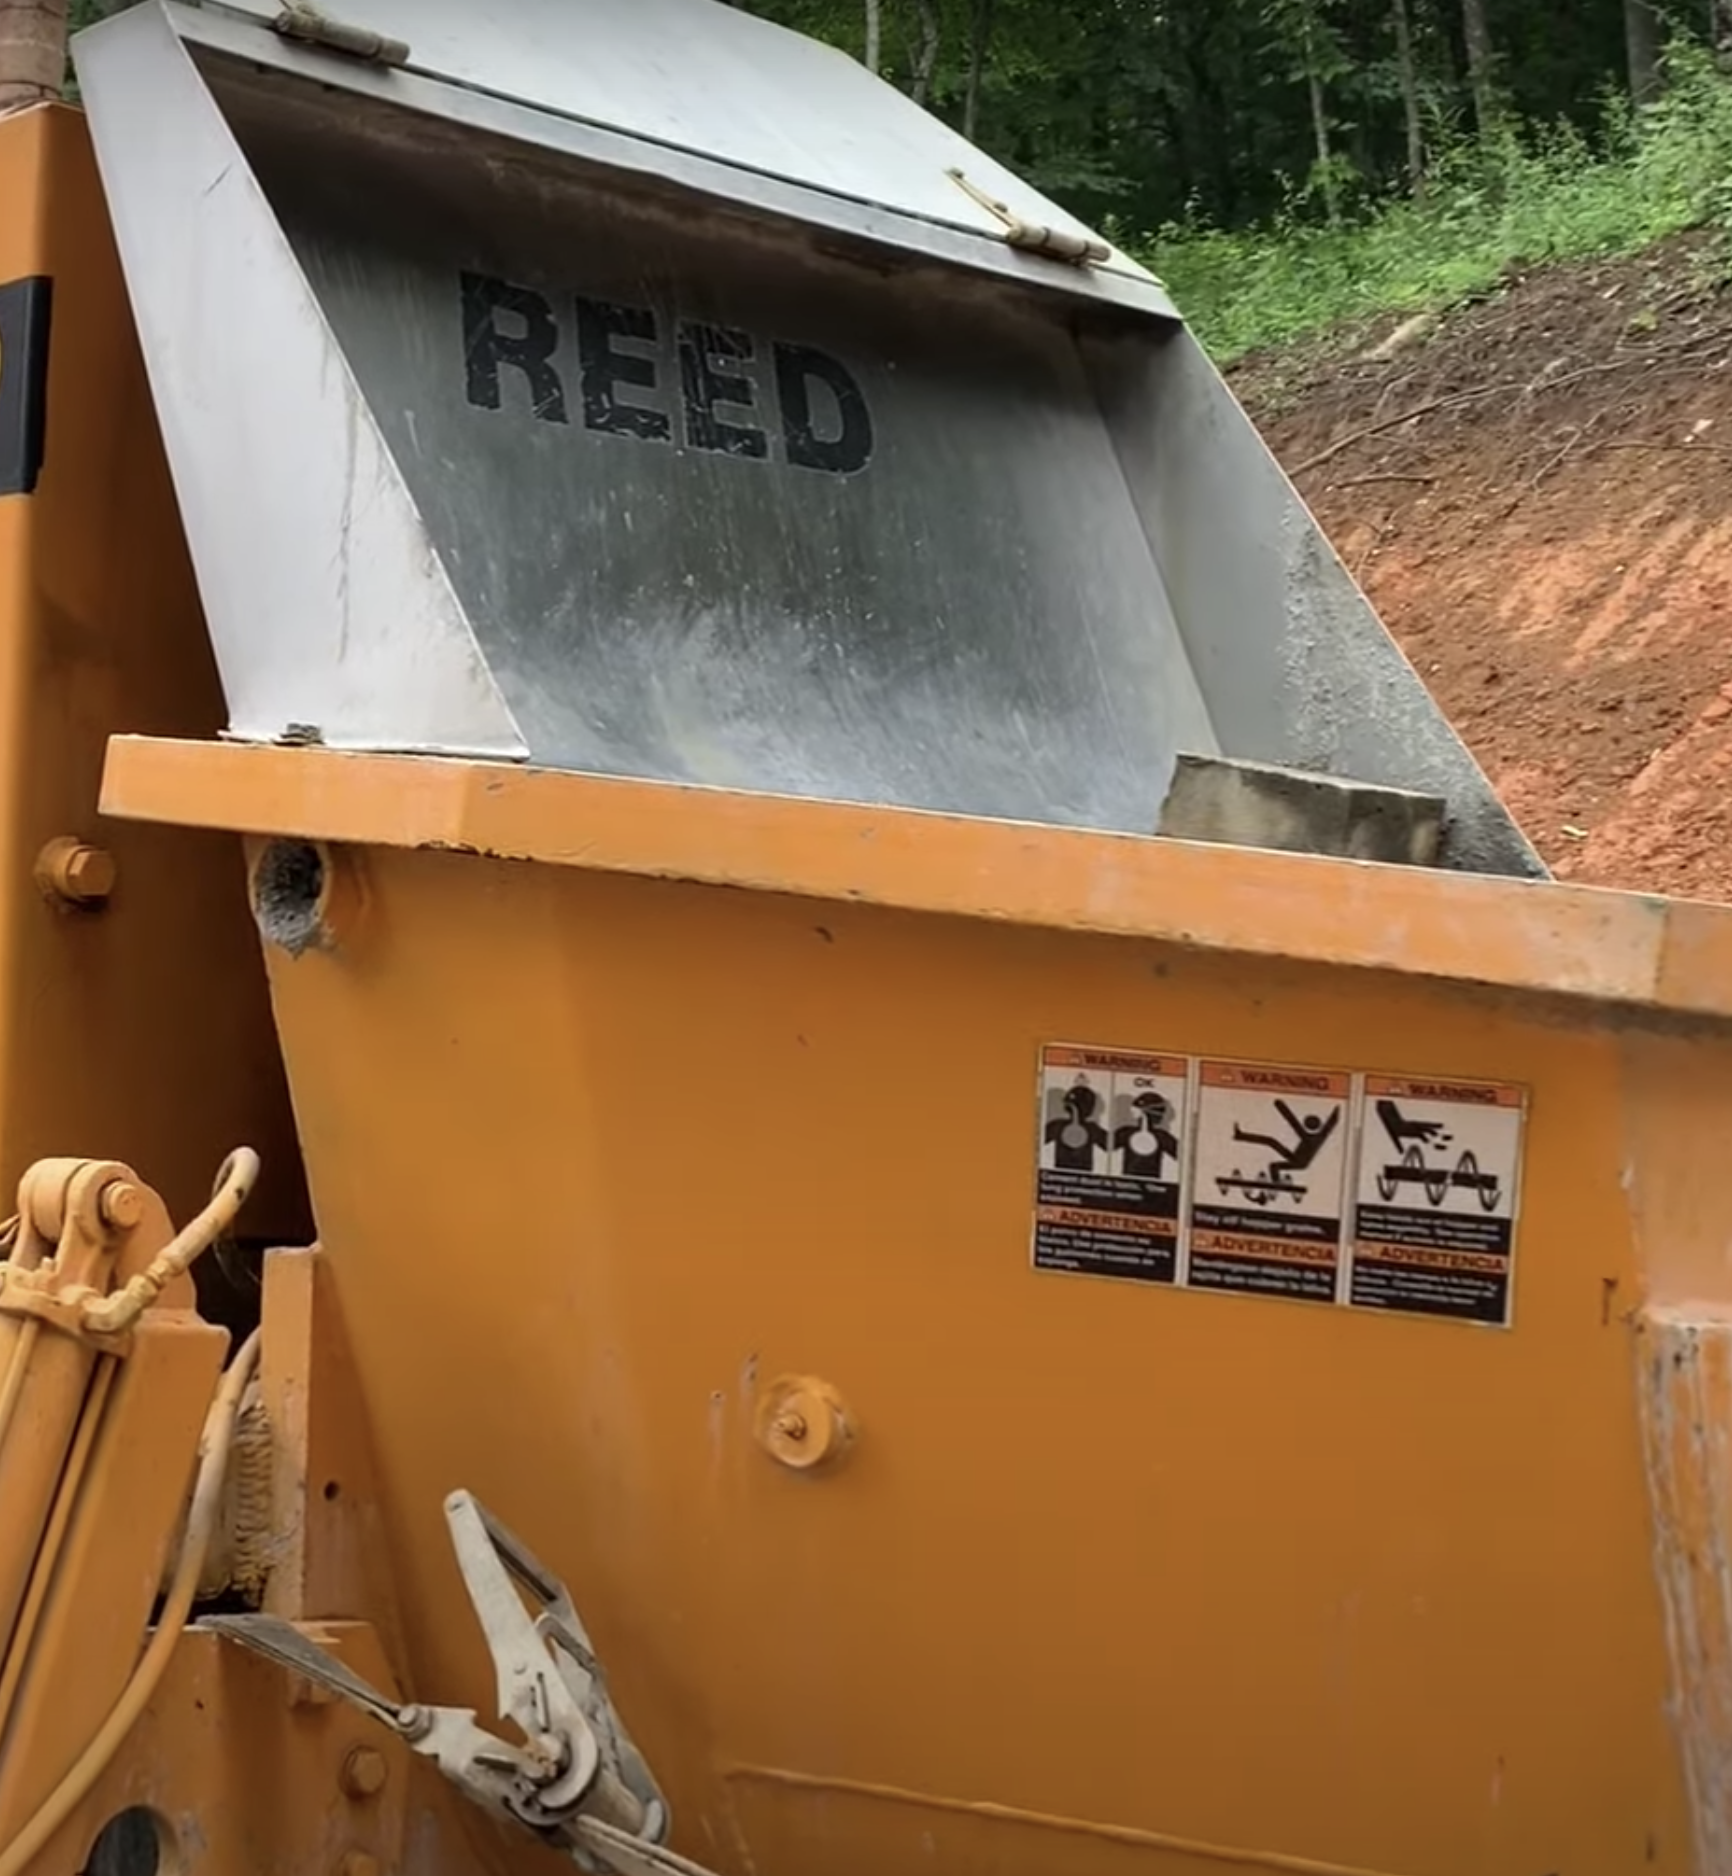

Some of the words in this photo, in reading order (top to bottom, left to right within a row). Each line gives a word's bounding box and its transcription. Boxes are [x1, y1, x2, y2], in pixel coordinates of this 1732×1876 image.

[460, 269, 874, 475] REED
[1083, 1053, 1162, 1073] WARNING
[1133, 1077, 1154, 1088] OK
[1240, 1070, 1330, 1091] WARNING
[1409, 1083, 1497, 1104] WARNING
[1059, 1210, 1172, 1233] ADVERTENCIA
[1211, 1236, 1335, 1261] ADVERTENCIA
[1380, 1246, 1505, 1271] ADVERTENCIA
